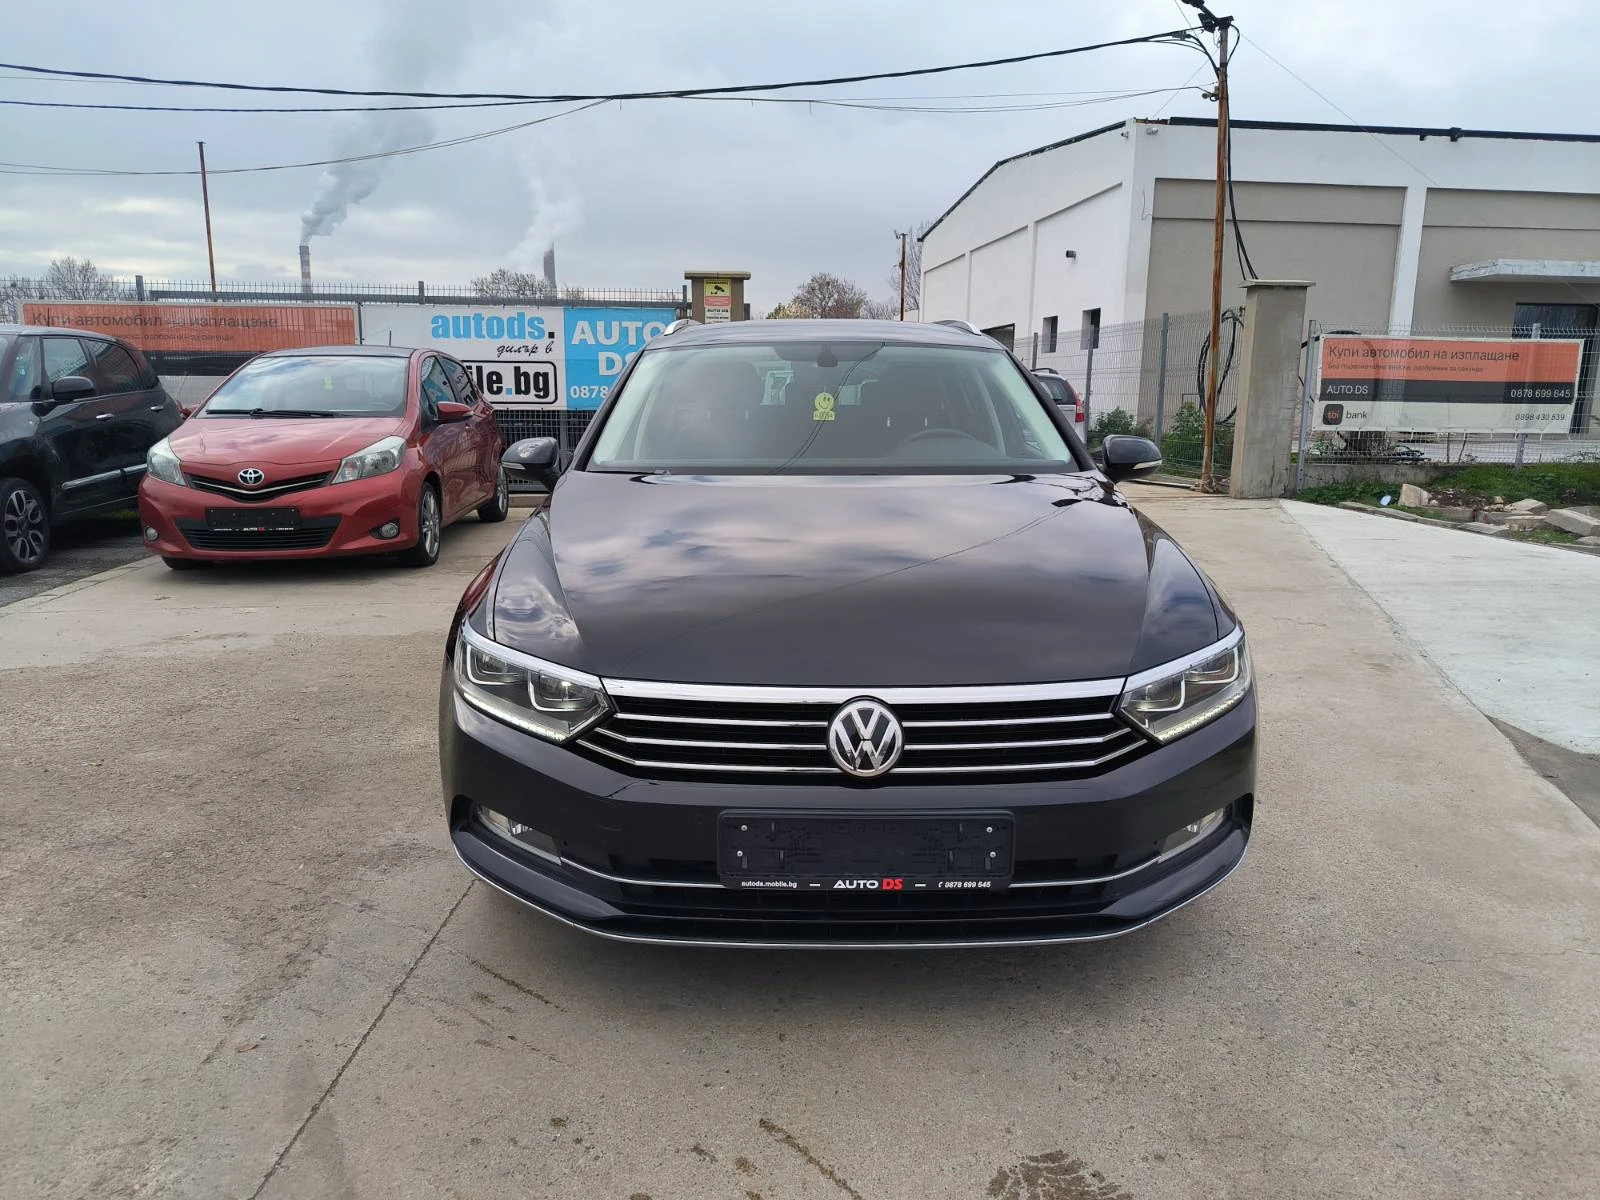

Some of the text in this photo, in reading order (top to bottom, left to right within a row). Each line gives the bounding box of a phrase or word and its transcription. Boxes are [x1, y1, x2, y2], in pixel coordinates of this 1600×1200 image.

[76, 314, 163, 327] автомобил
[191, 316, 278, 329] изплащане
[497, 343, 540, 357] дилър
[1328, 345, 1520, 362] Купи автомобил на изплащане
[598, 352, 637, 376] D
[463, 365, 550, 400] le.bg
[570, 385, 609, 399] 0878
[1326, 385, 1369, 394] AUTO DS
[1510, 388, 1571, 398] 0878 699 645
[1345, 410, 1368, 419] bank
[1515, 413, 1565, 421] 0898 430 539
[832, 878, 904, 890] AUTO DS
[944, 881, 962, 889] 0878
[963, 881, 977, 889] 699
